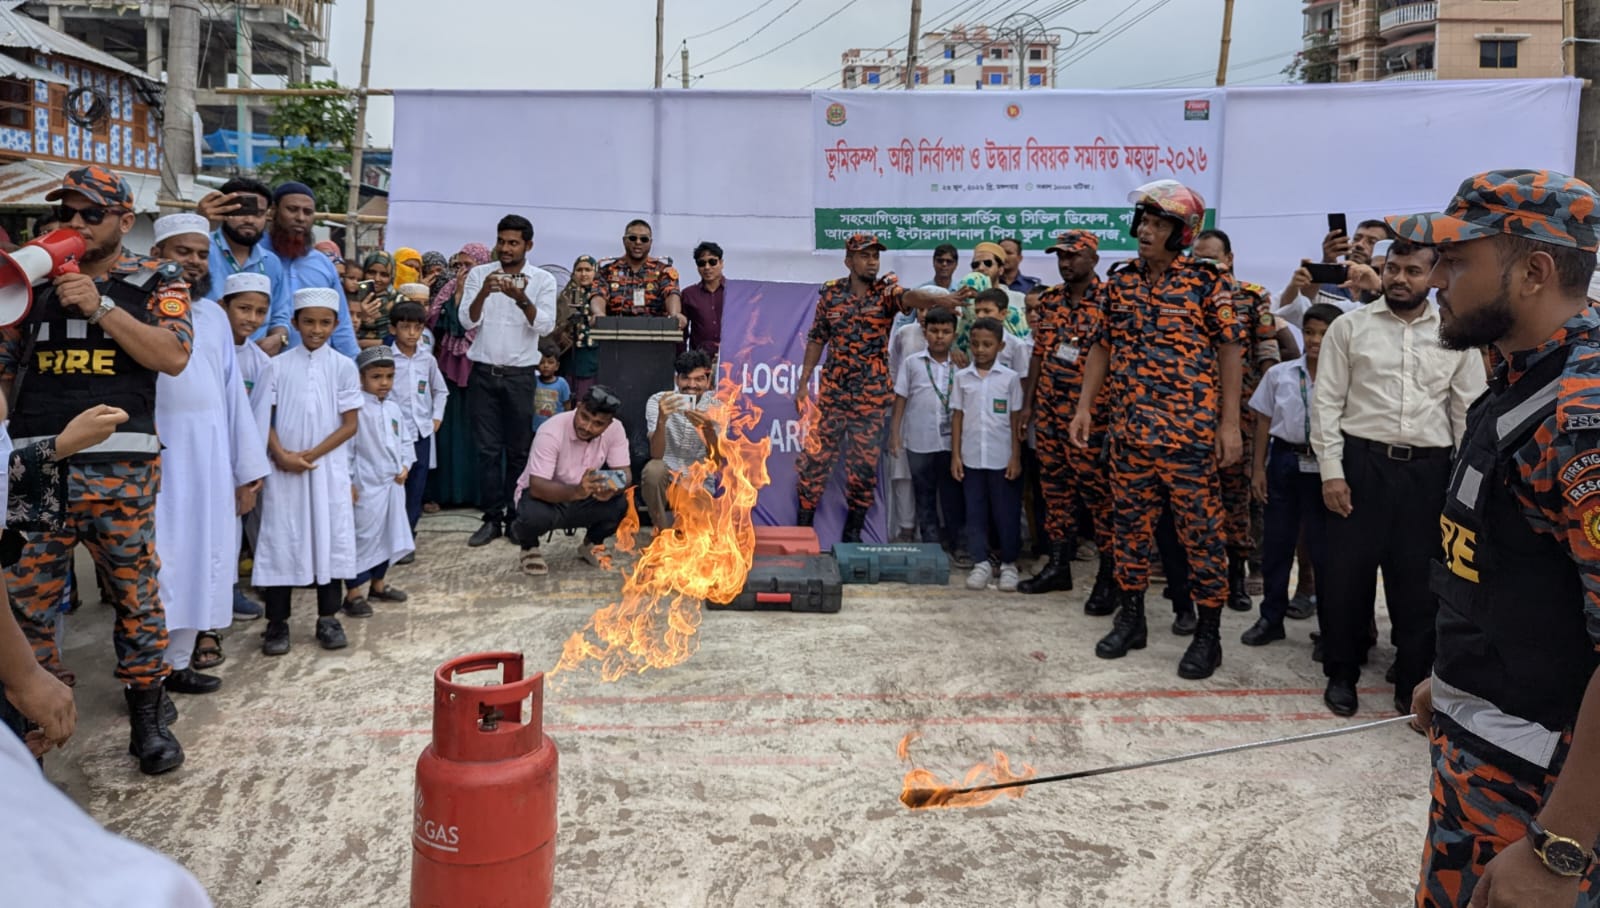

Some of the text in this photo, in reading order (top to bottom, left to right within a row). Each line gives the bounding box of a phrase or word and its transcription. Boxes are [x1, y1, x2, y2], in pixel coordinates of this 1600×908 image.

[825, 136, 1208, 182] ভূমিকম্প, অগ্নি নির্বাপণ ও উদ্ধার বিষয়ক সমন্বিত মহড়া-২০২৬
[920, 213, 957, 225] ফায়ার
[961, 209, 1000, 225] সার্ভিস
[1005, 214, 1016, 224] ও
[1021, 209, 1060, 225] সিভিল
[989, 225, 1016, 240] পিস
[37, 349, 116, 376] FIRE
[1567, 413, 1600, 428] FSC
[1563, 461, 1583, 482] FIRE
[1569, 480, 1600, 500] RES
[424, 820, 459, 844] GAS
